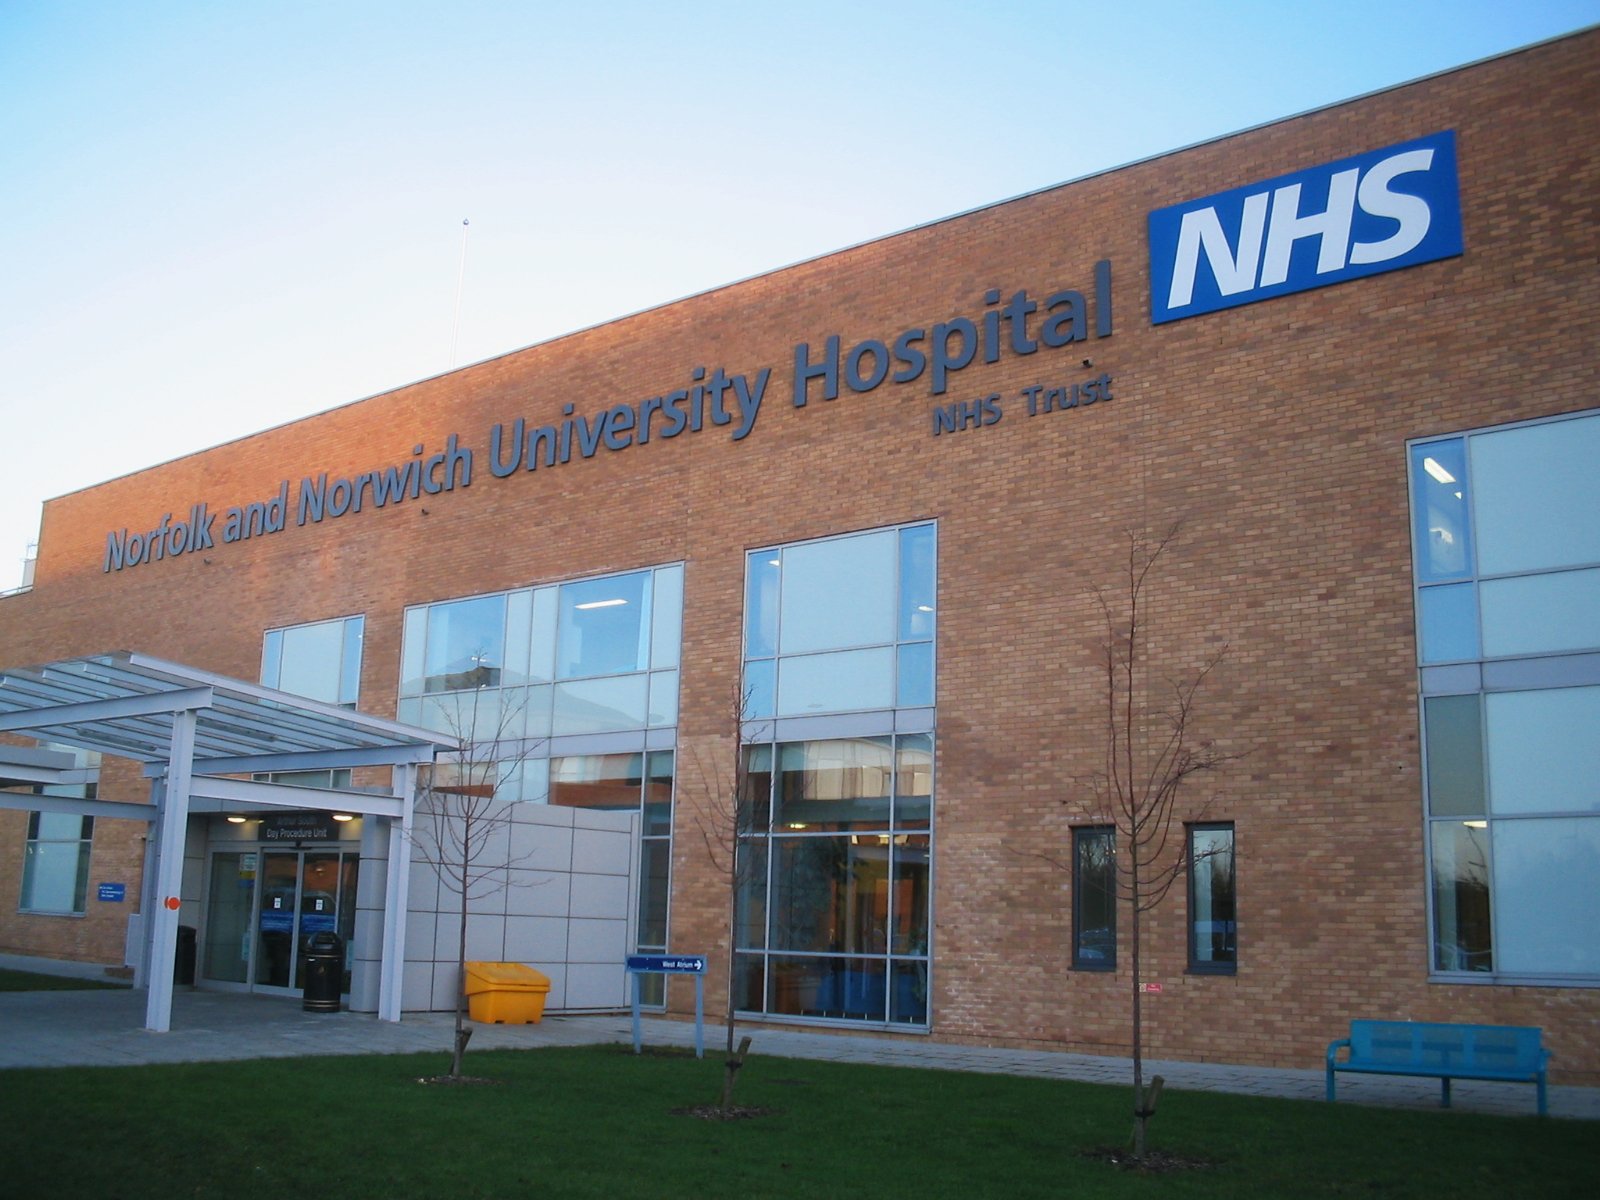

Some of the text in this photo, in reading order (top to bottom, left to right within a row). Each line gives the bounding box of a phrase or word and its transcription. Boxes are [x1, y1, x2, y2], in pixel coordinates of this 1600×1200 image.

[1167, 148, 1435, 309] NHS
[103, 259, 1113, 573] Norfolk and Norwich University Hospital
[932, 371, 1115, 436] NHS Trust
[266, 828, 327, 839] Day Procedure Unit
